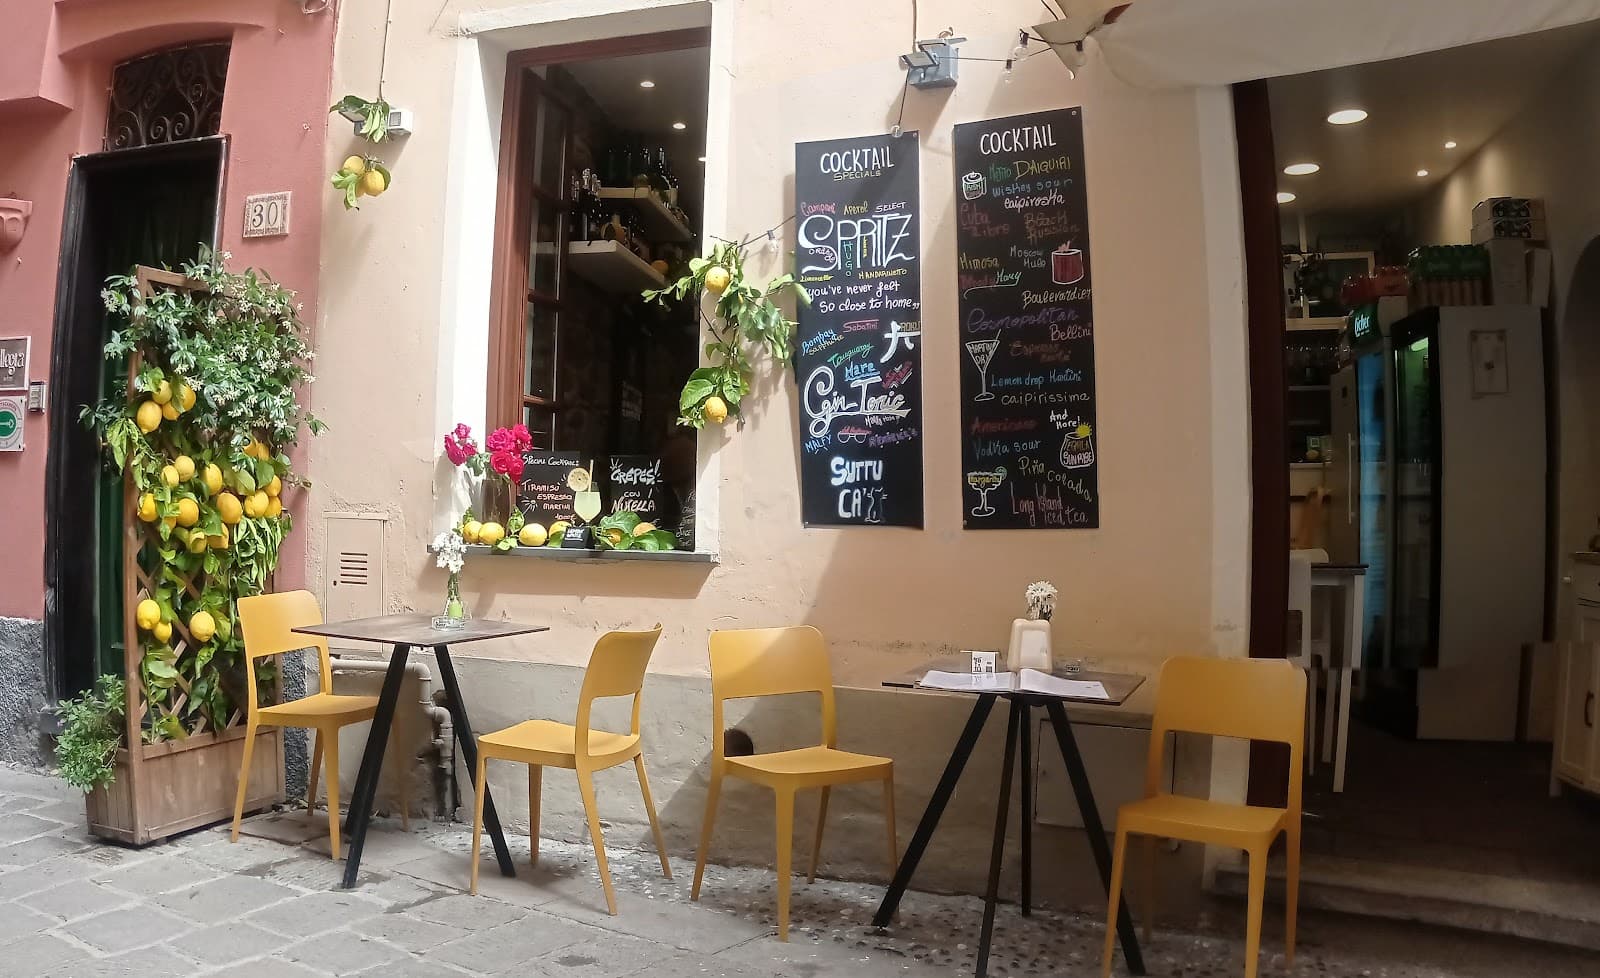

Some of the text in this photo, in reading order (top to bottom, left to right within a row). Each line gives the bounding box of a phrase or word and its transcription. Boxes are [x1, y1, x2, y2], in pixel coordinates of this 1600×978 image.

[979, 124, 1057, 155] COCKTAIL
[820, 146, 895, 173] COCKTAIL
[833, 170, 882, 181] SPECIALS
[252, 201, 279, 228] 30
[874, 201, 908, 213] SELECT
[797, 213, 916, 274] SPRITZ
[846, 283, 873, 295] never
[876, 280, 901, 298] felt
[838, 298, 867, 311] close
[869, 298, 883, 311] to
[1049, 408, 1069, 423] And
[830, 456, 883, 486] SUTTU
